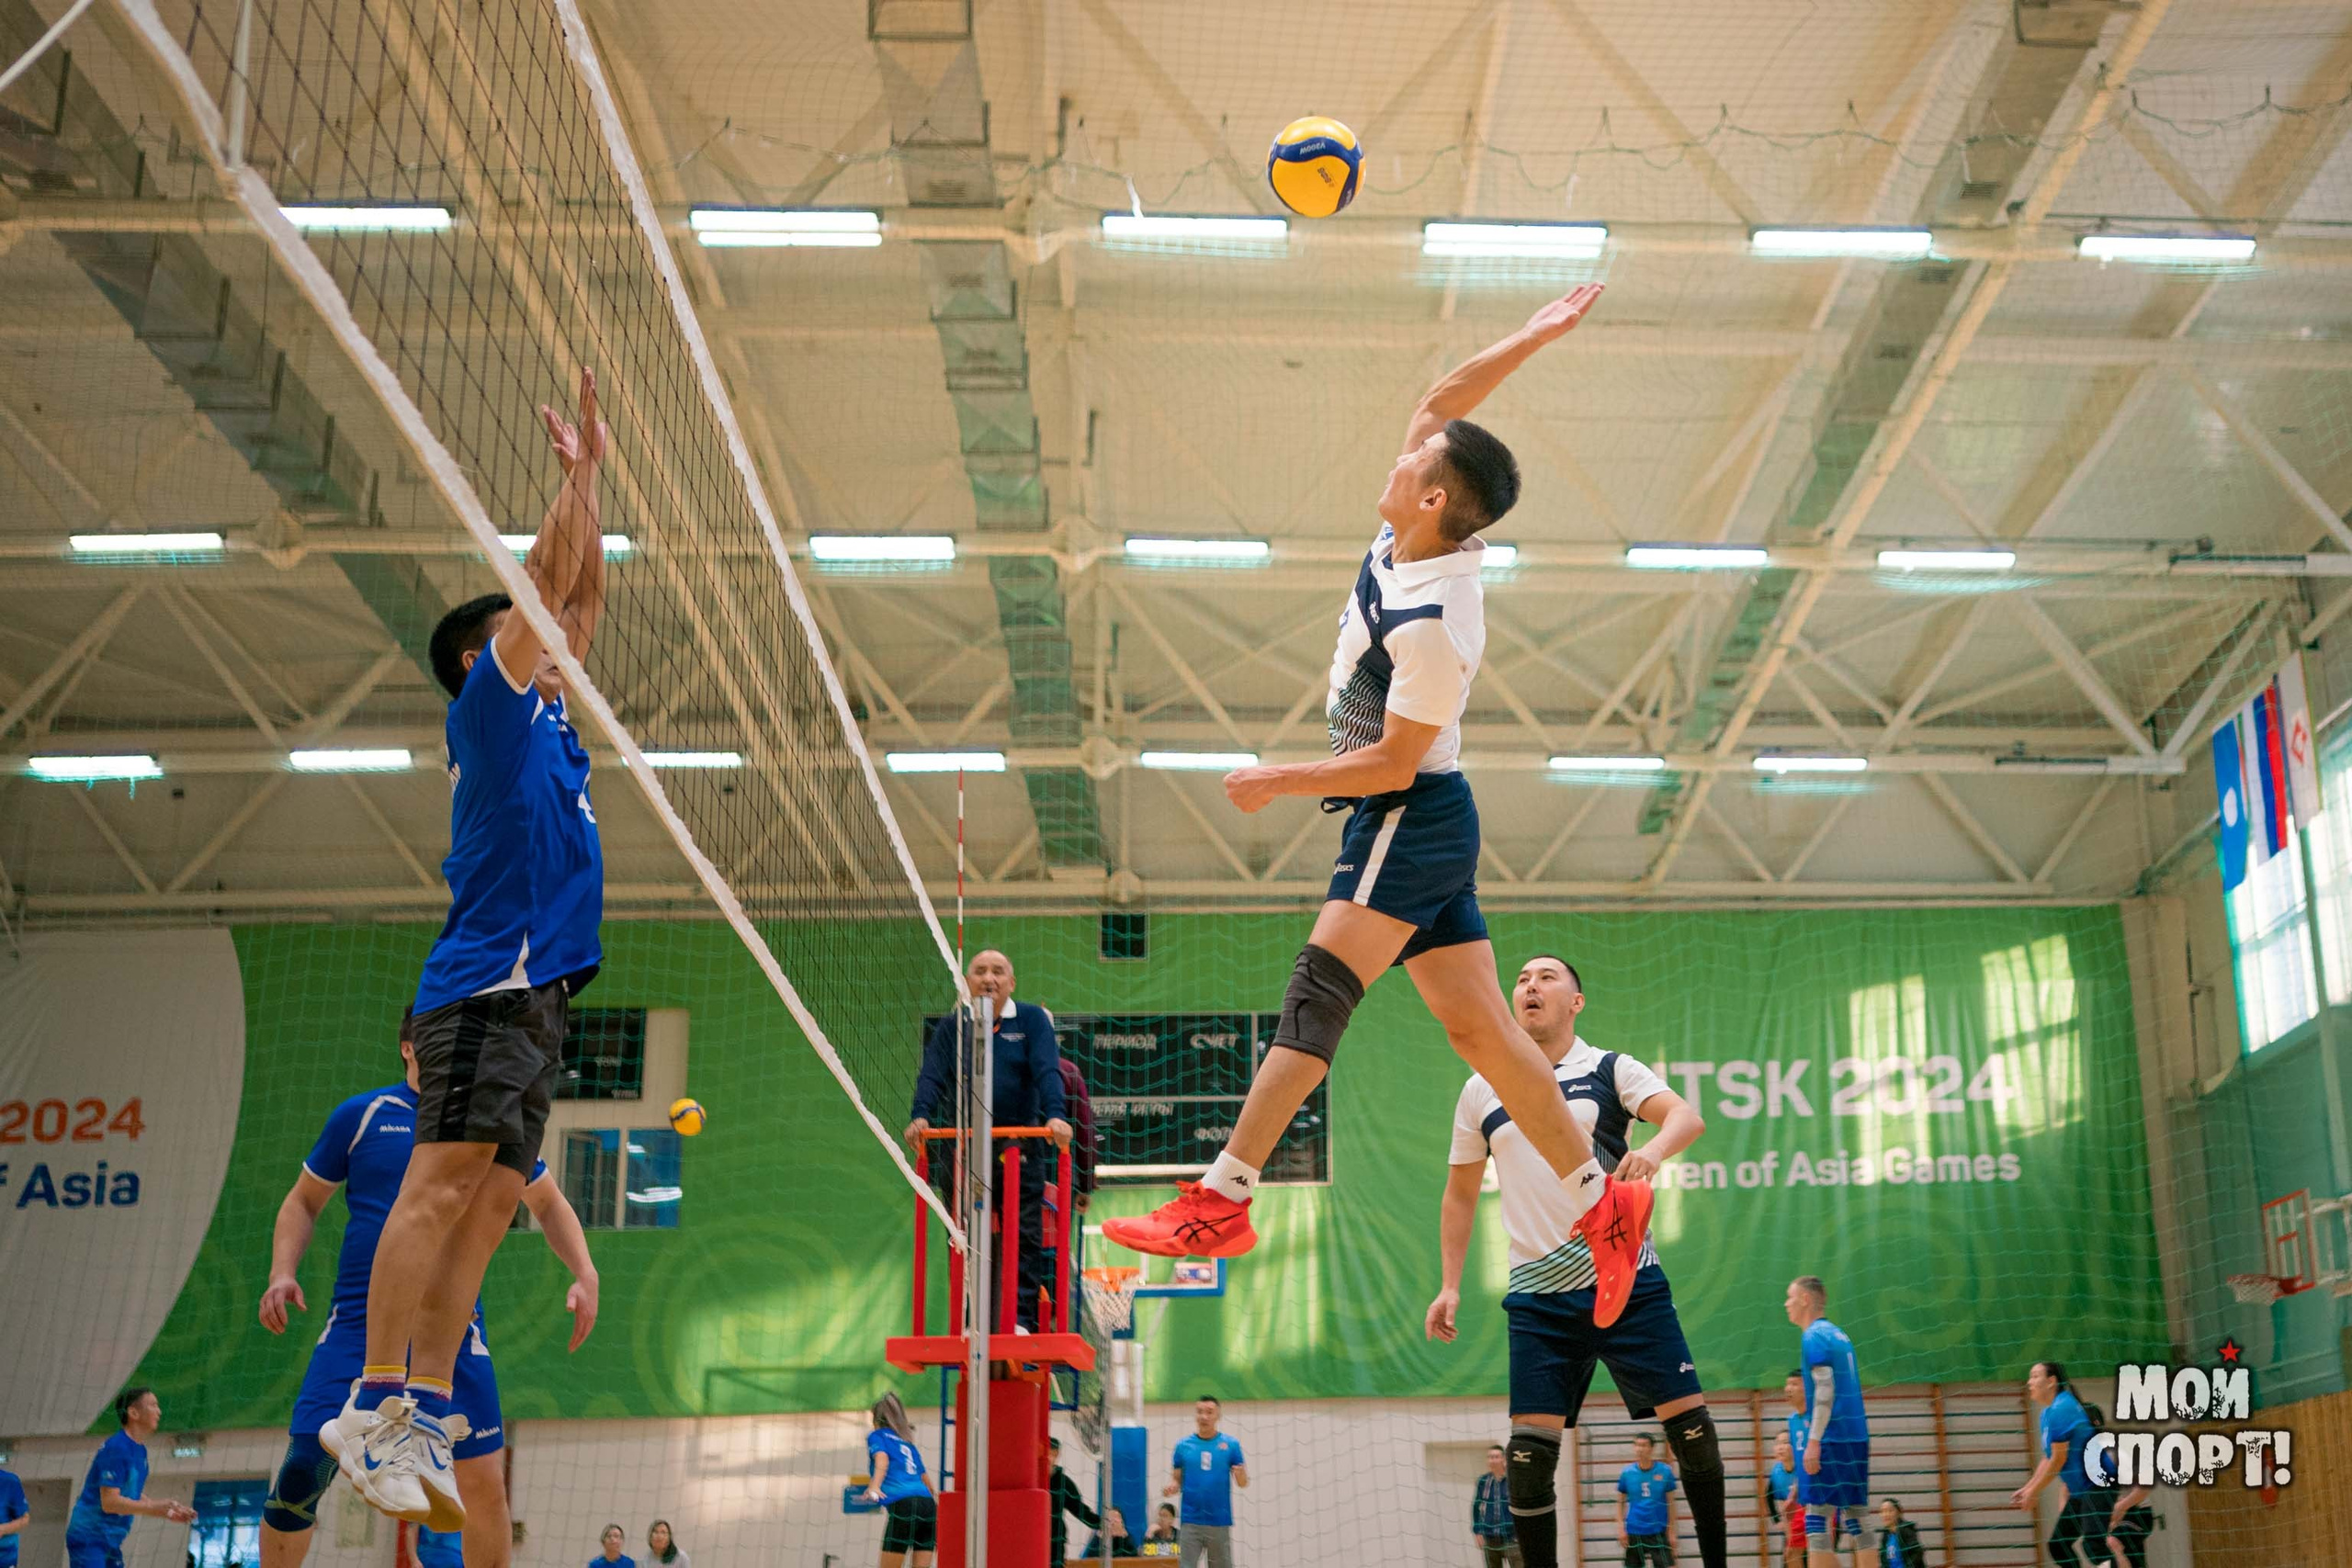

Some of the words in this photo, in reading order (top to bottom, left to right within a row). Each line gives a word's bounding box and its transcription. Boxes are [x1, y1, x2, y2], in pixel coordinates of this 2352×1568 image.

[1093, 1033, 1157, 1050] ПЕРИОД
[1190, 1033, 1238, 1049] СЧЕТ
[1650, 1060, 1814, 1119] TSK
[1829, 1054, 2014, 1125] 2024
[0, 1096, 145, 1145] 2024
[17, 1159, 140, 1209] Asia
[1736, 1150, 1780, 1188] of
[1785, 1150, 1875, 1187] Asia
[1883, 1147, 2020, 1185] Games
